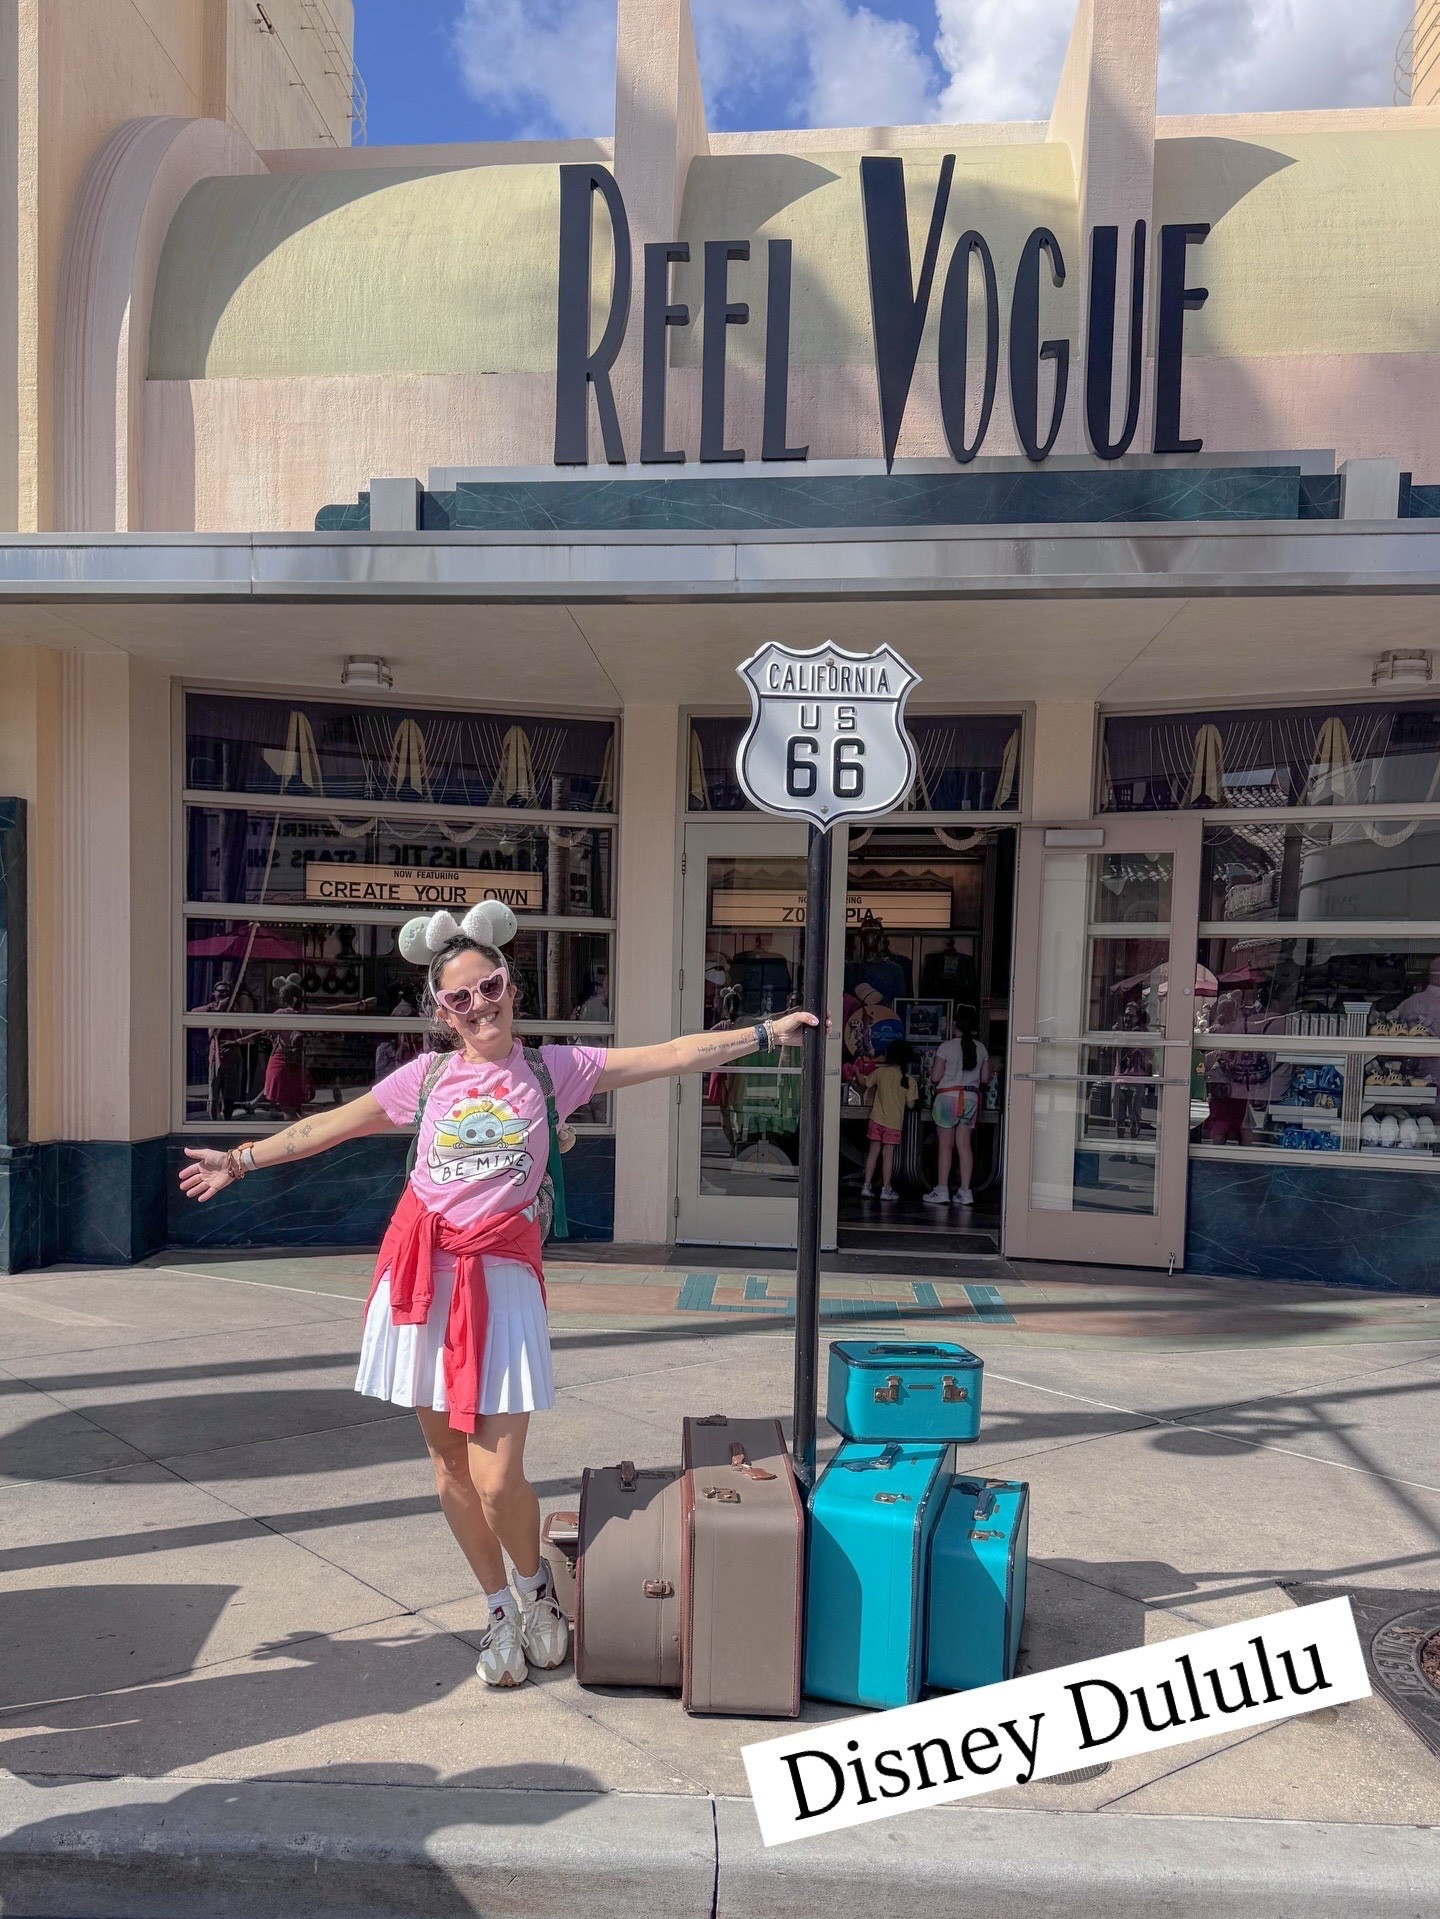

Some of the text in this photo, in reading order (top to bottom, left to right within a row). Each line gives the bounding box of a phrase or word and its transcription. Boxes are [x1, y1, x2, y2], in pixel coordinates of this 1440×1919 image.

[553, 153, 1212, 476] REEL VOGUE
[768, 662, 890, 693] CALIFORNIA
[786, 735, 866, 799] 66
[393, 870, 460, 881] NOW FEATURING
[319, 880, 529, 906] CREATE YOUR OWN
[441, 1154, 527, 1181] BE MINE
